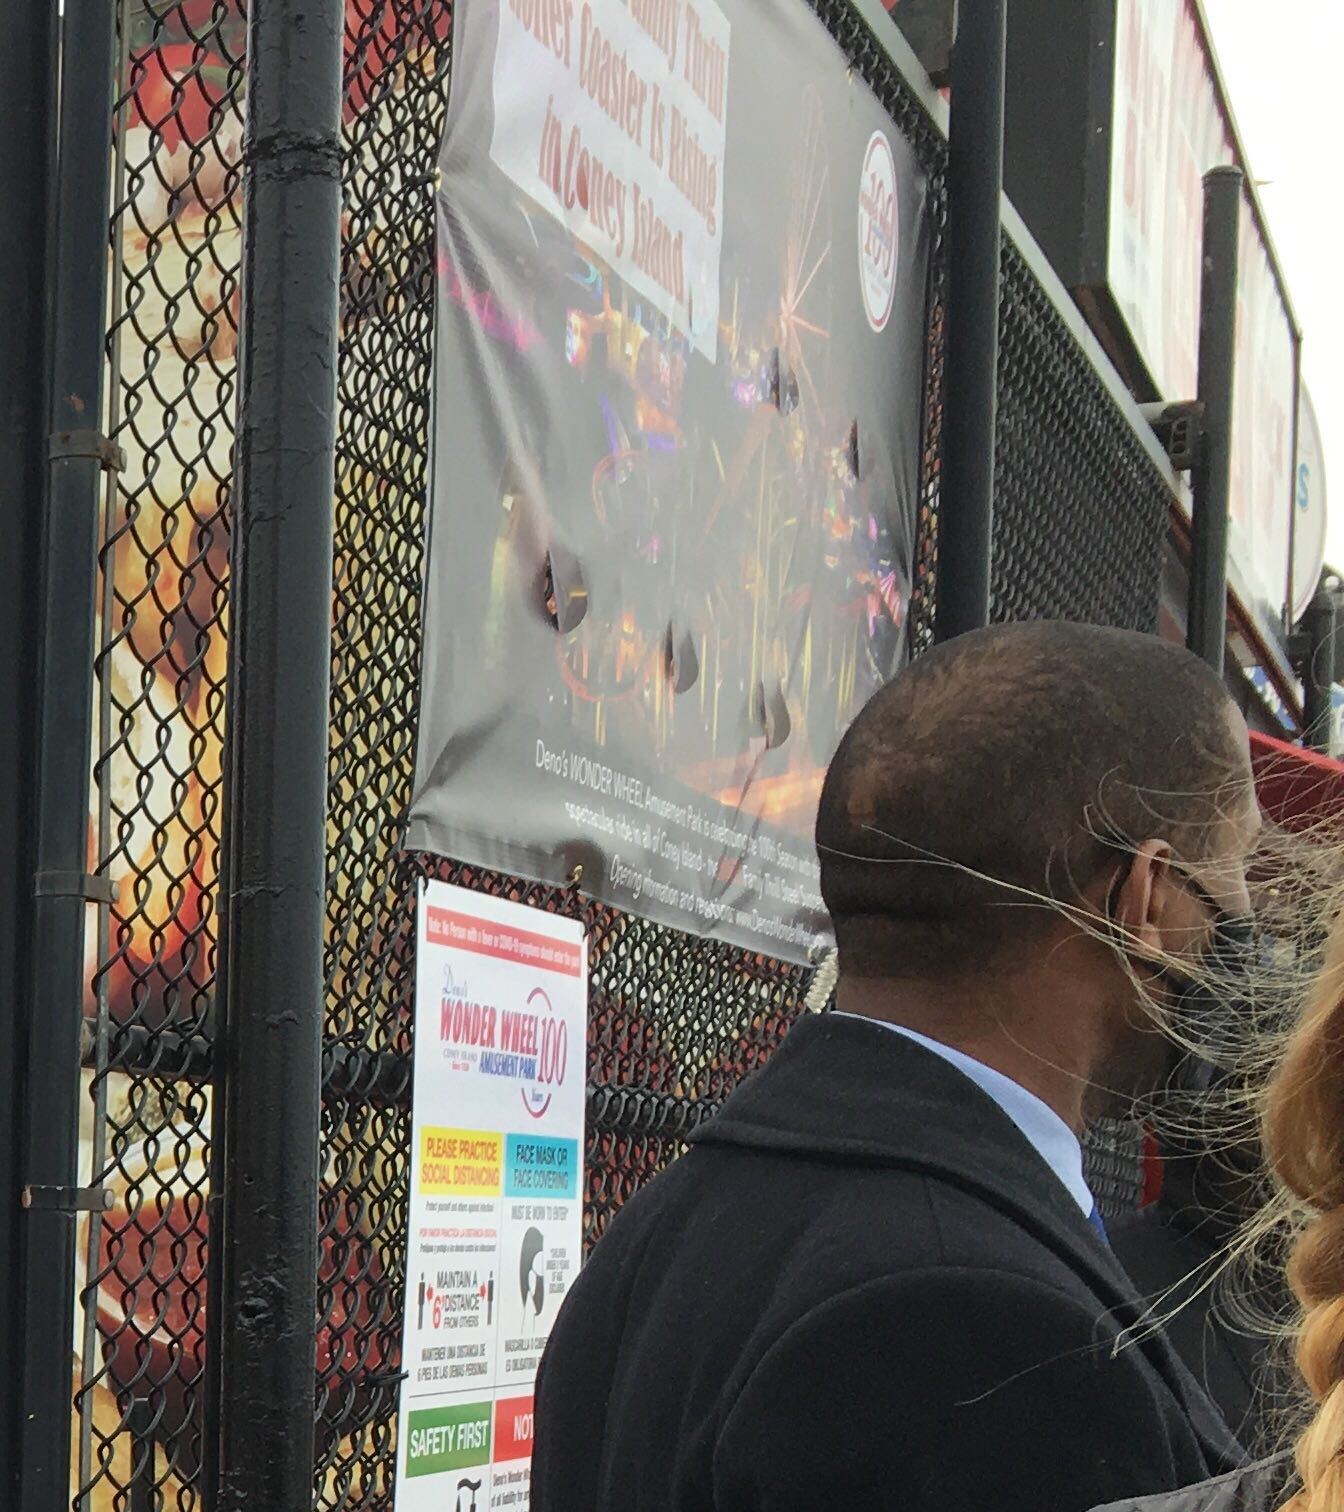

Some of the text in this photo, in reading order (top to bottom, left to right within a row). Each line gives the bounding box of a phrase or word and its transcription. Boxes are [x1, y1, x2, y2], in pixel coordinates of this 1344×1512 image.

[579, 2, 647, 148] Coaster
[649, 82, 665, 169] Is
[668, 104, 718, 237] Rising
[538, 94, 684, 305] in Coney Island
[535, 738, 569, 778] Deno's
[570, 751, 612, 795] WONDER
[613, 771, 644, 808] WHEEL
[610, 853, 641, 900] Opening
[440, 997, 568, 1087] WONDER WHEEL 100
[479, 1051, 519, 1079] AMUSEMENT
[519, 1056, 538, 1081] PARK
[426, 1137, 497, 1162] PLEASE PRACTICE
[516, 1144, 568, 1167] FACE MASK OR
[422, 1163, 500, 1187] SOCIAL DISTANCING
[513, 1168, 569, 1190] FACE COVERING
[436, 1270, 479, 1290] MAINTAIN A
[444, 1293, 481, 1312] DISTANCE
[443, 1315, 480, 1329] FROM OTHERS
[410, 1419, 489, 1459] SAFETY FIRST
[513, 1413, 534, 1442] NOT
